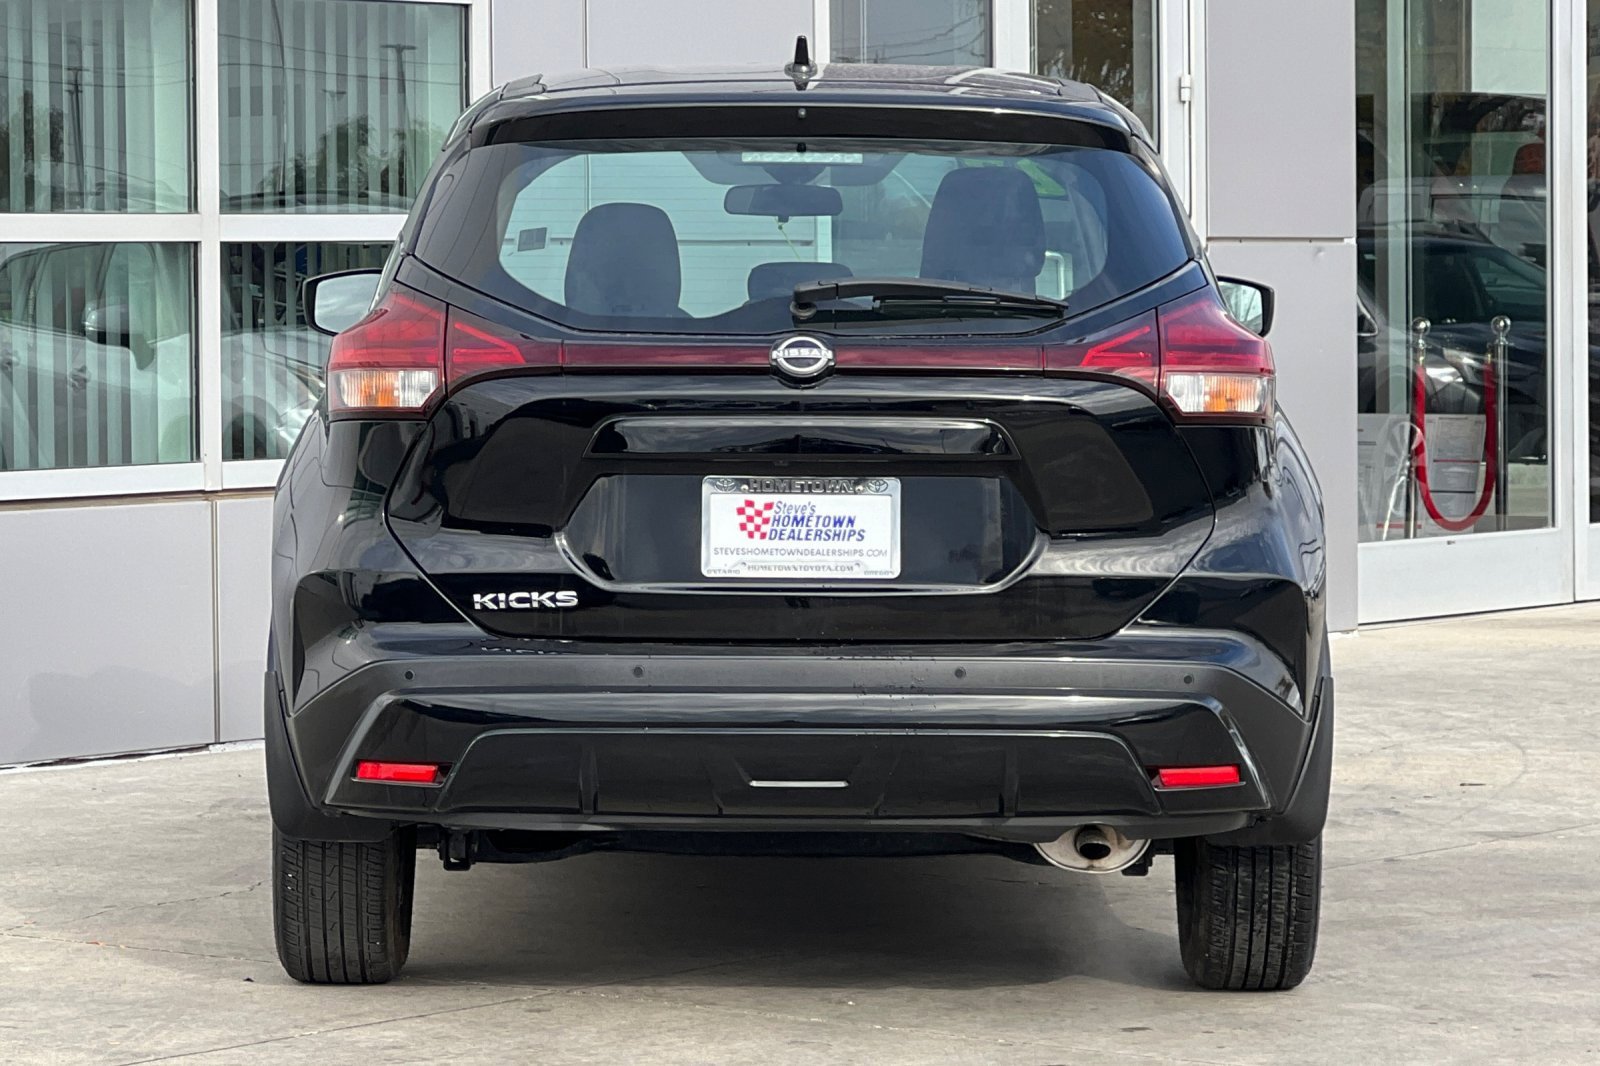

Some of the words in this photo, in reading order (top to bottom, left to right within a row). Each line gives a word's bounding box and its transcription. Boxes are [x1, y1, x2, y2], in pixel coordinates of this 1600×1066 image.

[772, 348, 833, 359] NISSAN
[748, 479, 854, 494] HOMETOWN
[774, 500, 816, 514] Steve's
[772, 515, 856, 528] HOMETOWN
[768, 528, 866, 541] DEALERSHIPS
[473, 590, 578, 610] KICKS
